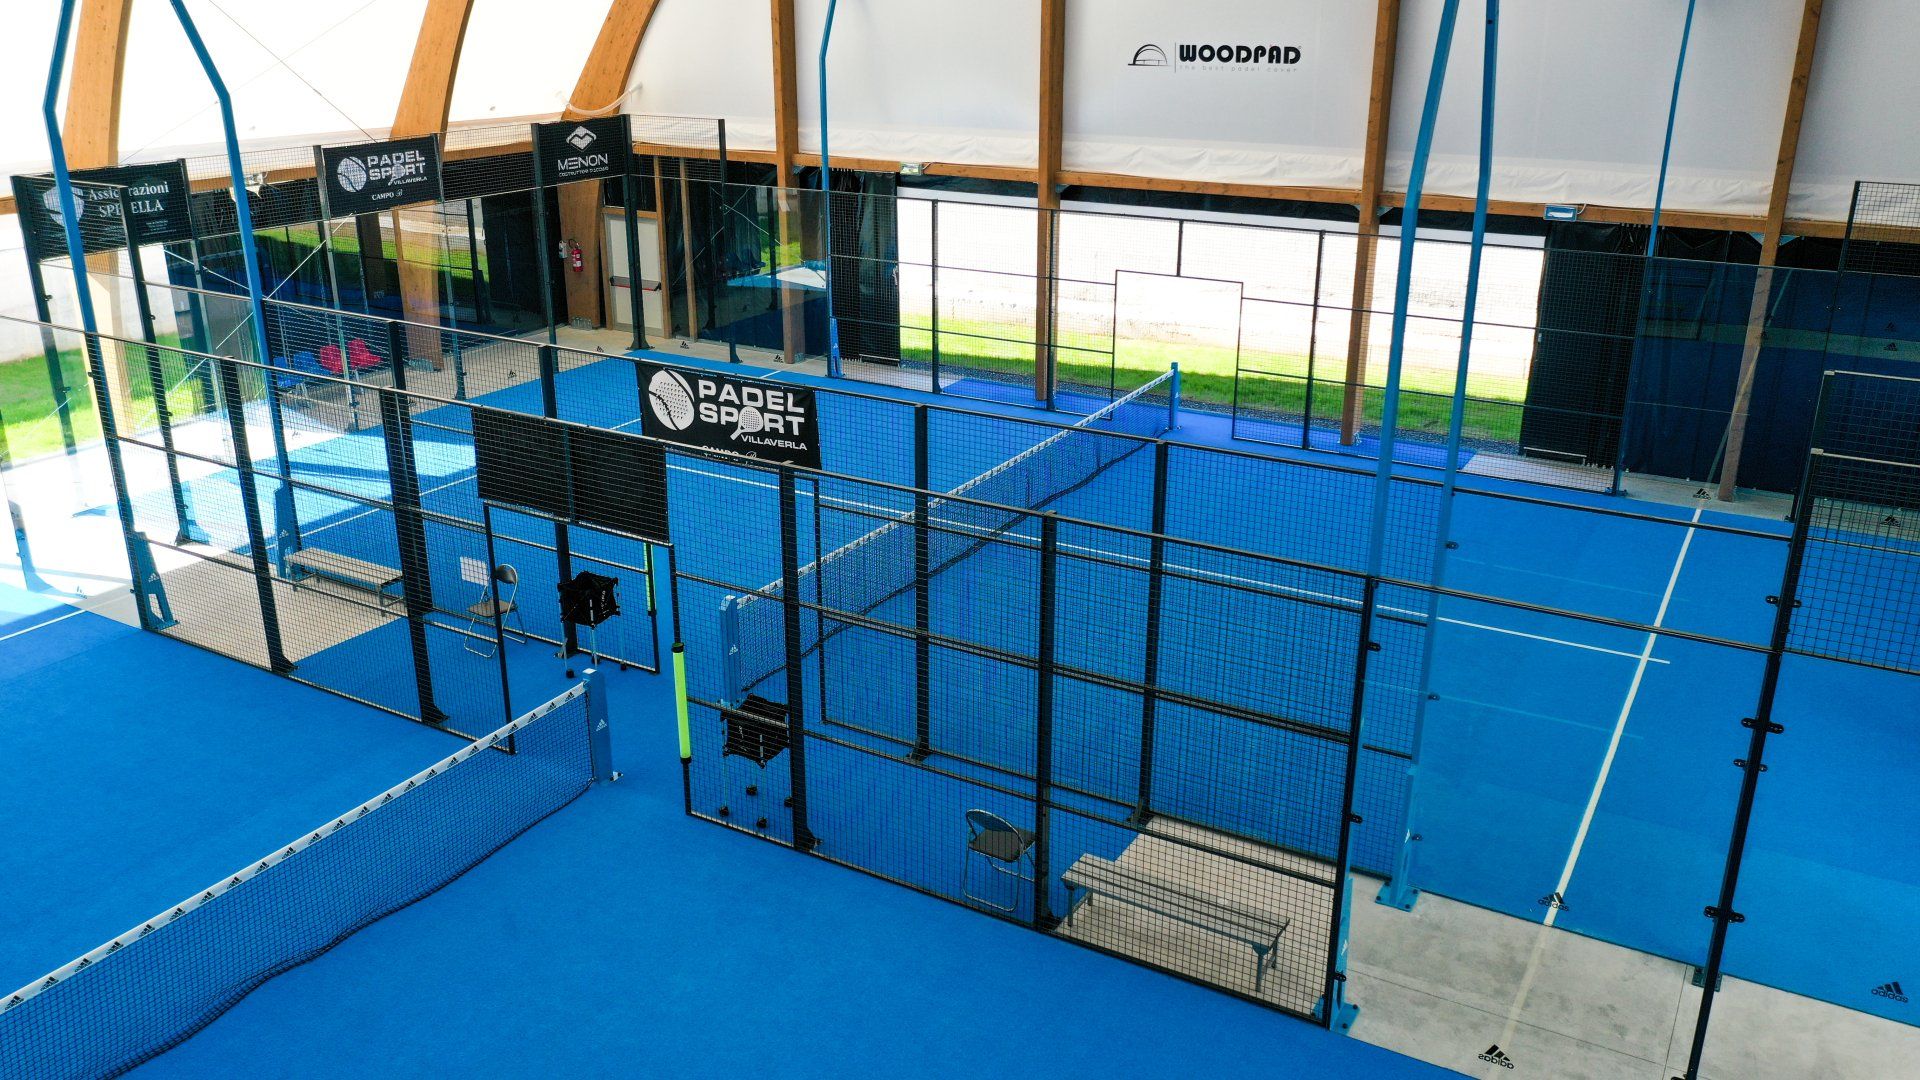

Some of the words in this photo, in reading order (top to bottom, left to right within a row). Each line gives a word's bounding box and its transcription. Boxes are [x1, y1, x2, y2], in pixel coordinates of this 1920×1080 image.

[1179, 45, 1301, 64] WOODPAD
[367, 150, 426, 167] PADEL
[557, 153, 608, 170] MENON
[369, 162, 426, 181] SPORT
[89, 181, 170, 201] Assicrazioni
[698, 380, 805, 414] PADEL
[699, 402, 805, 436] SPORT
[740, 434, 808, 451] VILLAVERLA
